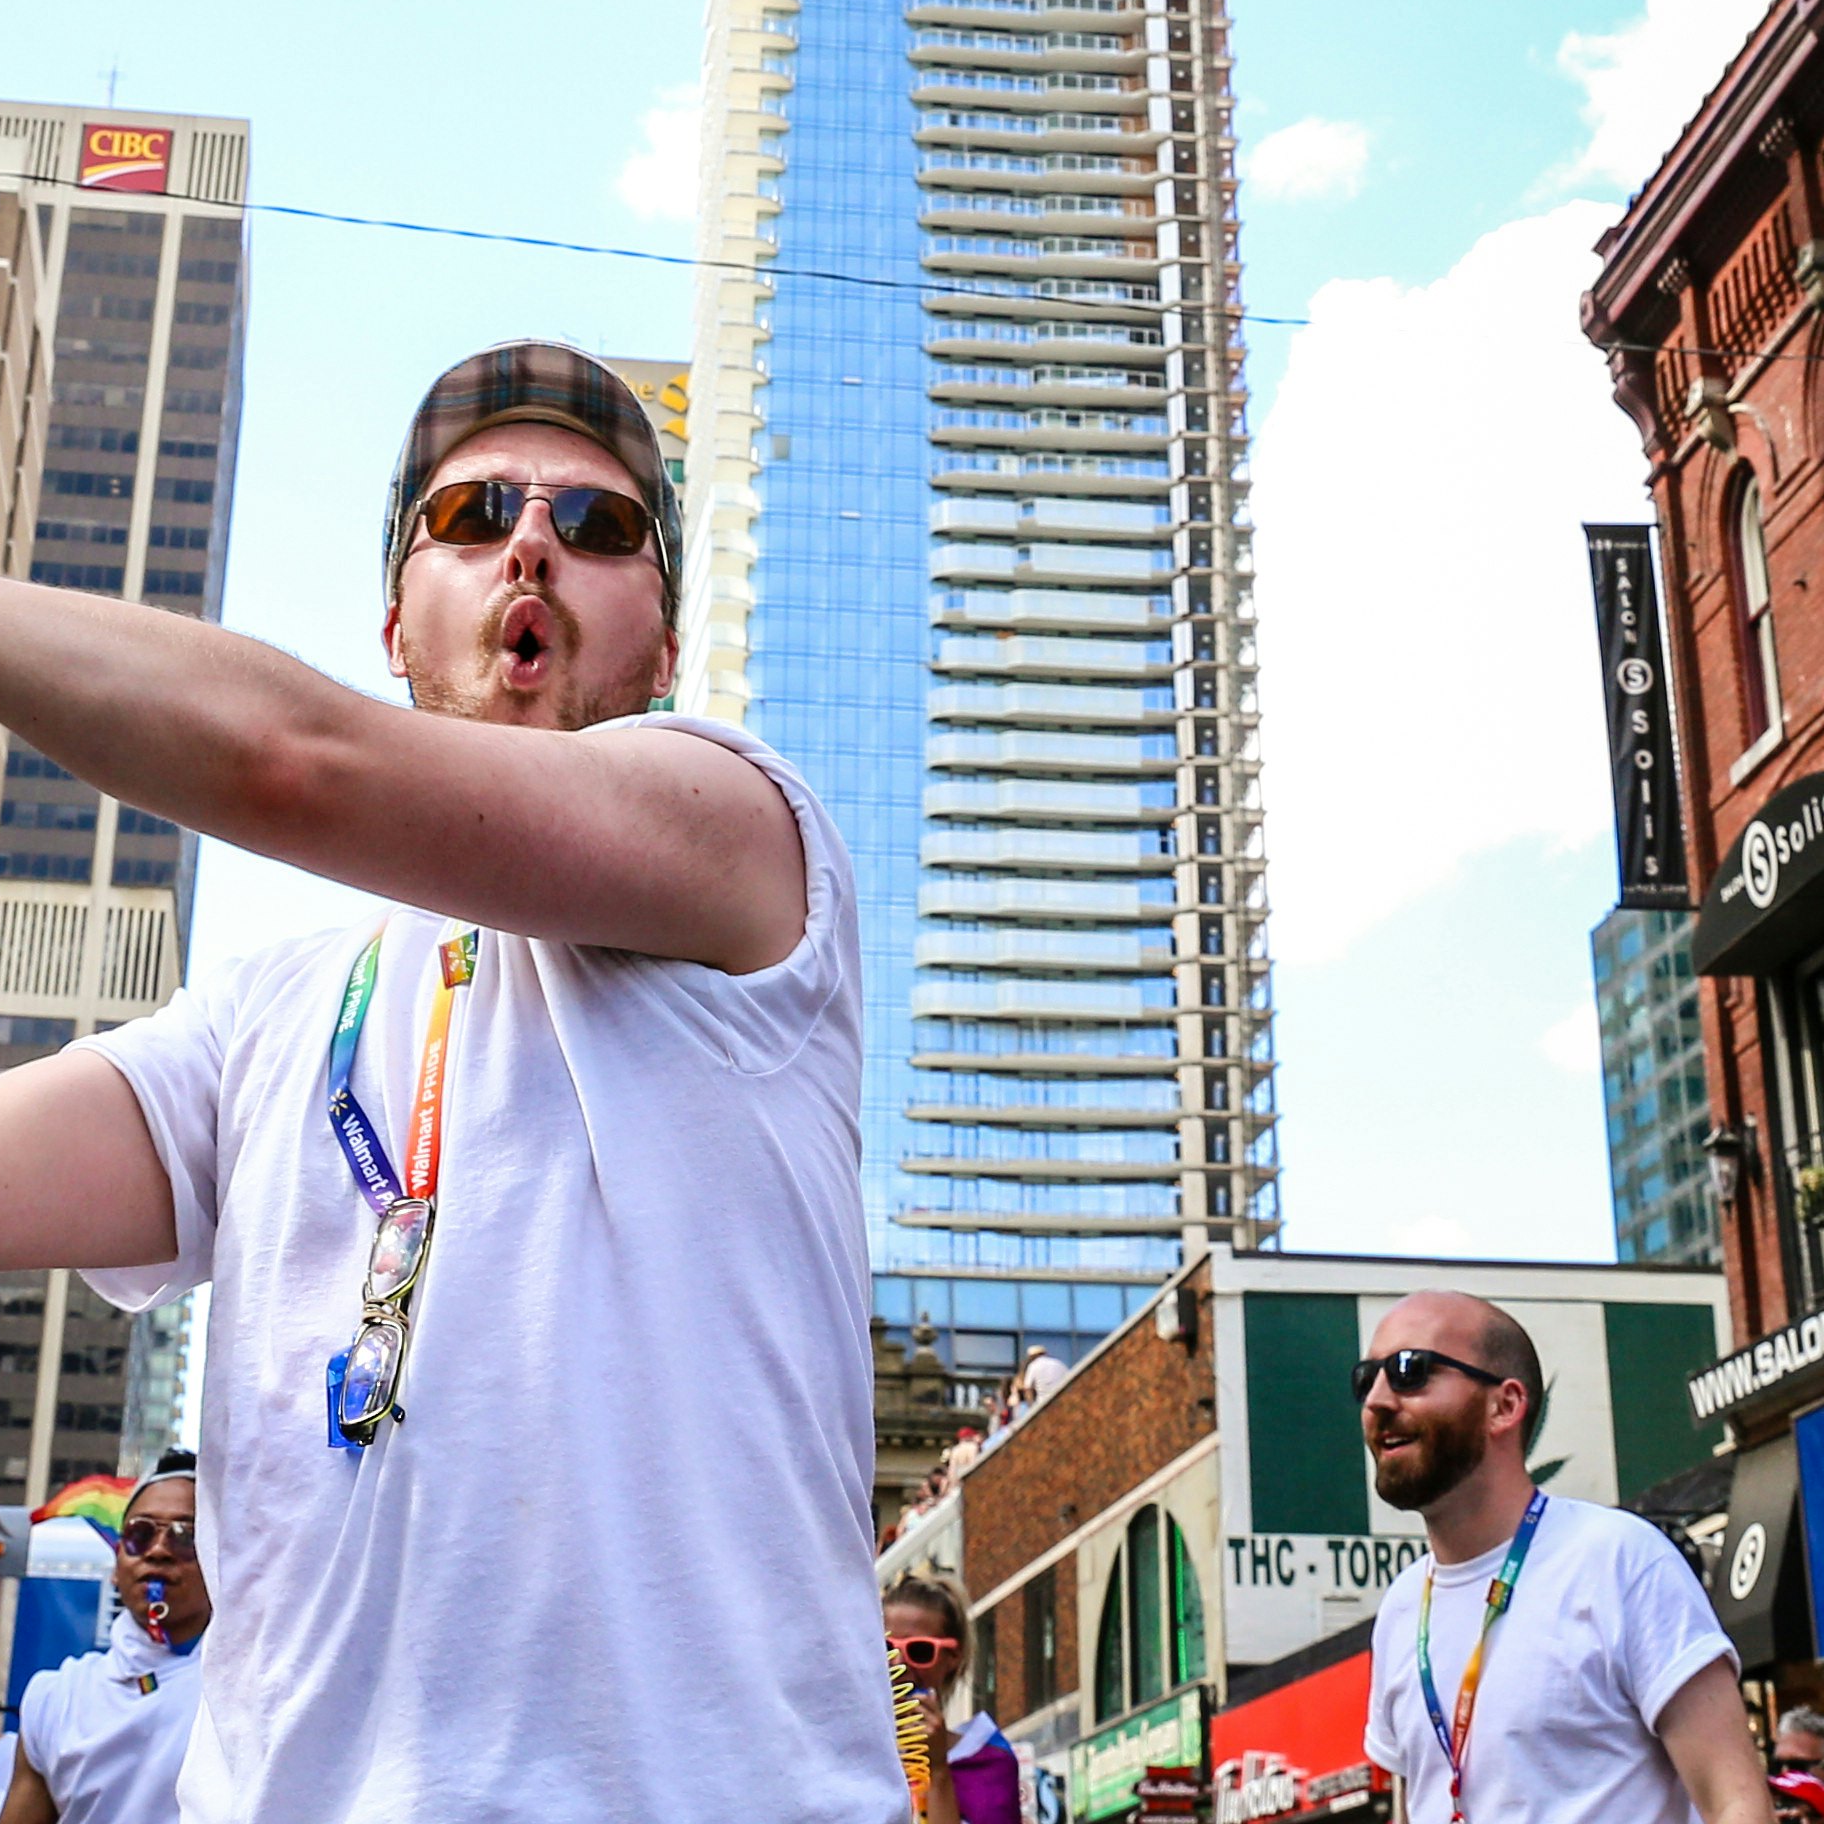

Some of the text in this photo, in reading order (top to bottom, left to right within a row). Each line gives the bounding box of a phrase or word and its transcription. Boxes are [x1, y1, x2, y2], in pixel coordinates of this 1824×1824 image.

[89, 129, 165, 160] CIBC
[338, 988, 362, 1035] PRIDE
[409, 1036, 443, 1191] Walmart PRIDE
[341, 1112, 387, 1198] Walmart
[1227, 1537, 1295, 1588] THC
